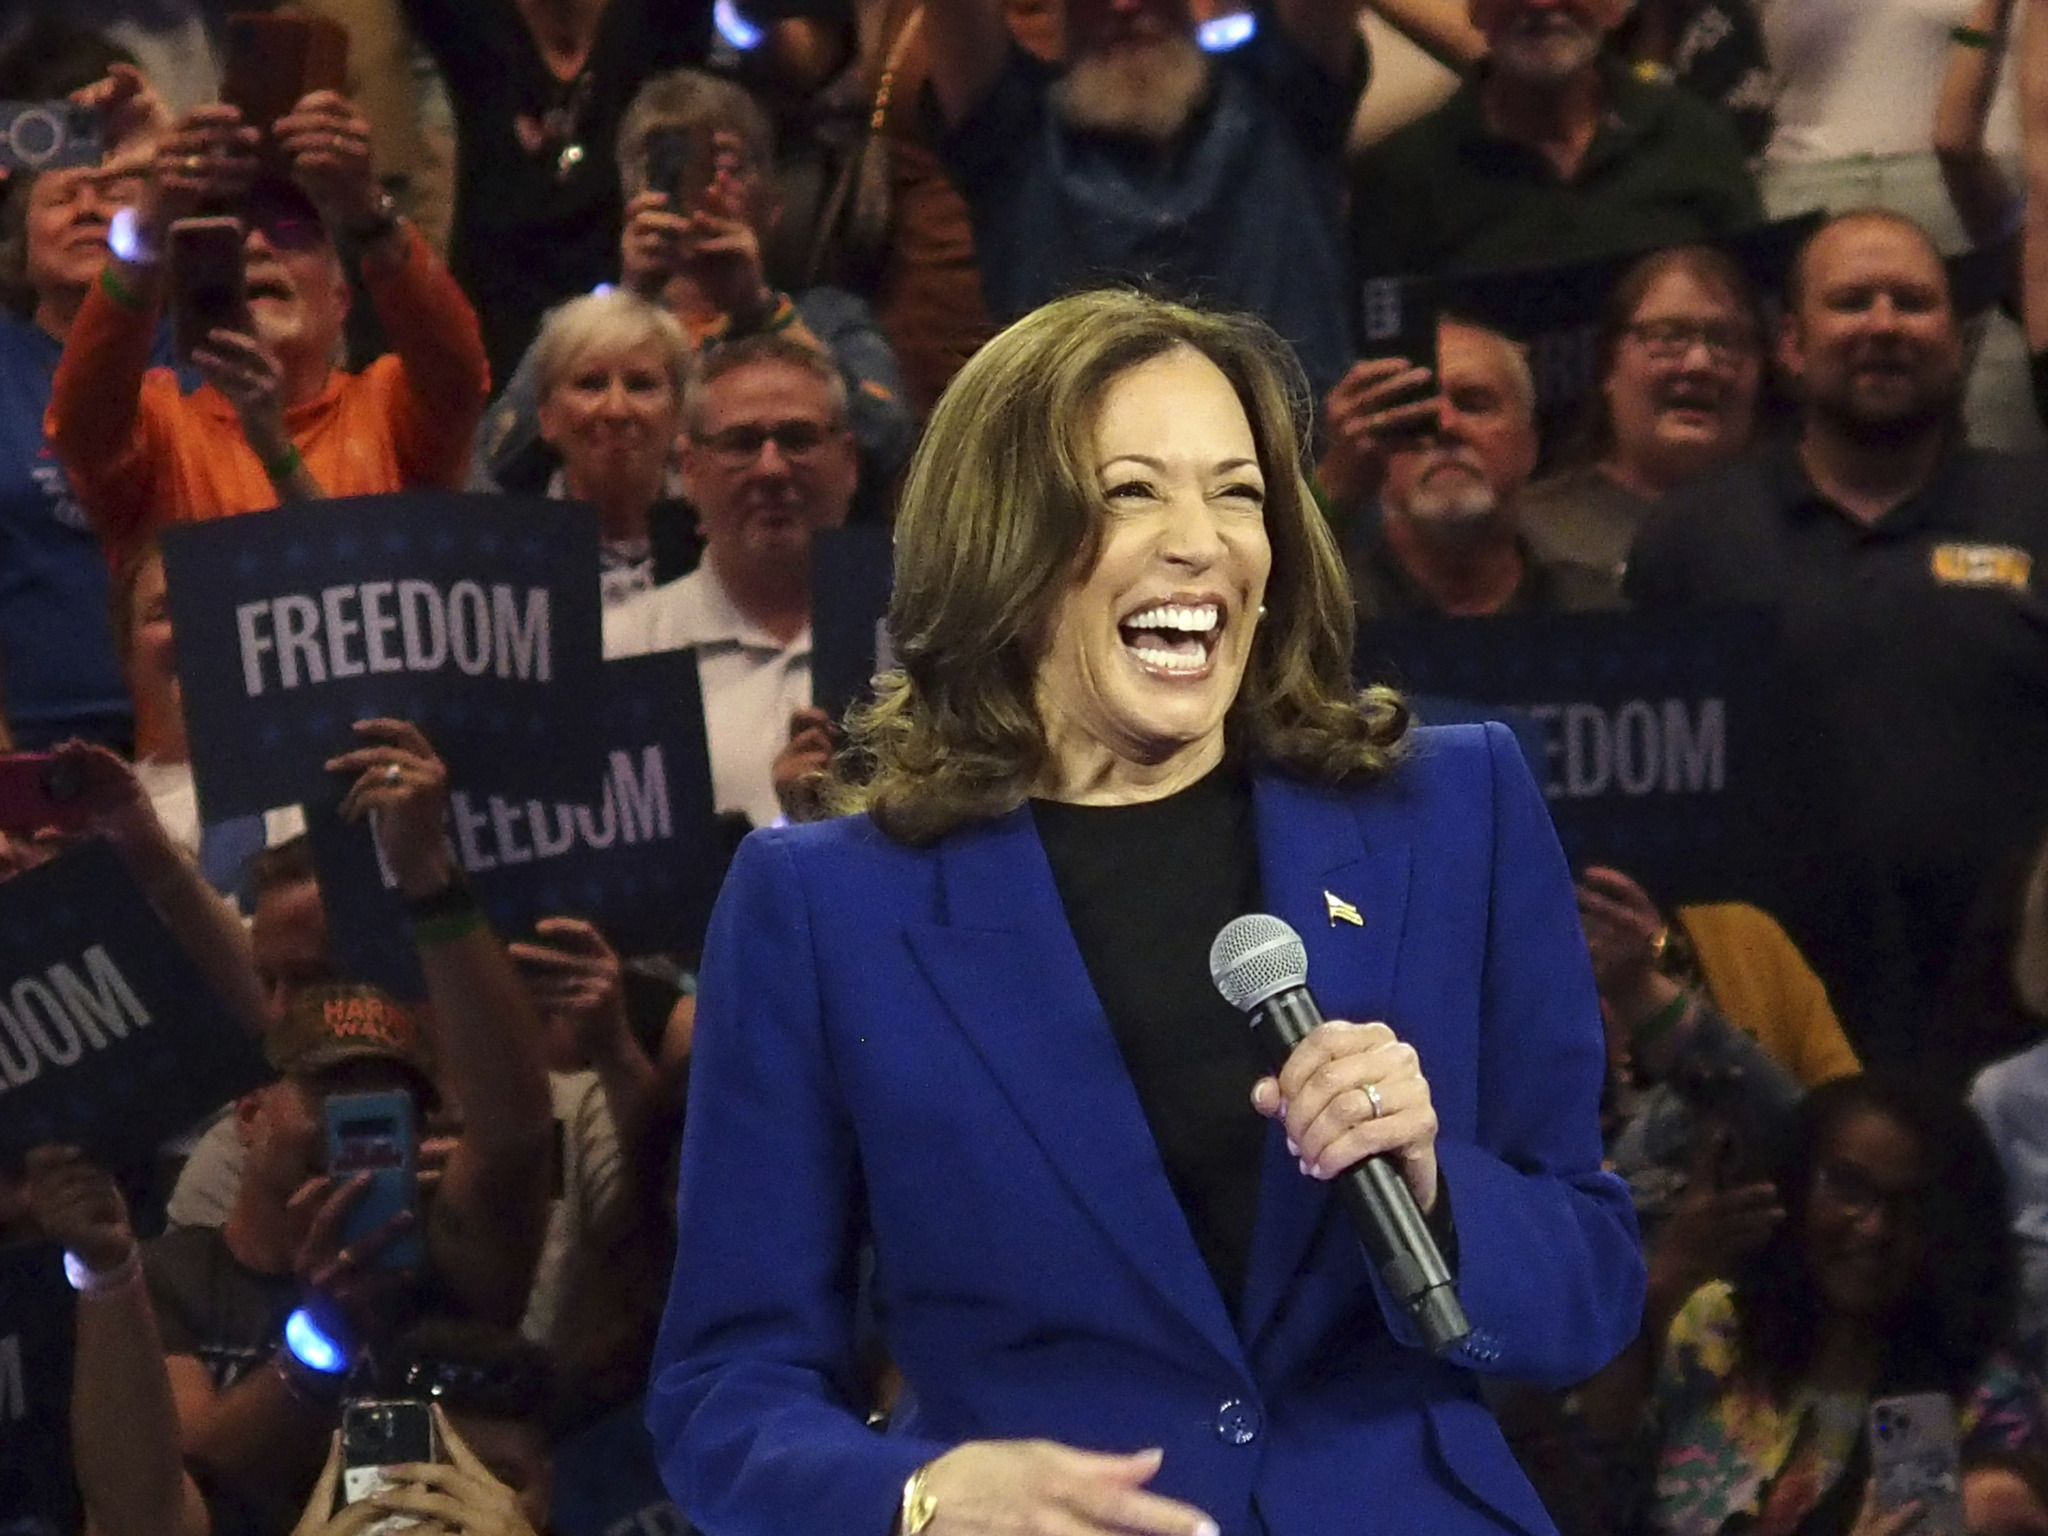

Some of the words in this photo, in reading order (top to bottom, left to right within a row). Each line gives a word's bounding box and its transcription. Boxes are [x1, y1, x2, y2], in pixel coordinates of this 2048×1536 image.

[236, 578, 551, 697] FREEDOM
[368, 743, 673, 890] EEDOM
[0, 943, 151, 1091] DOM
